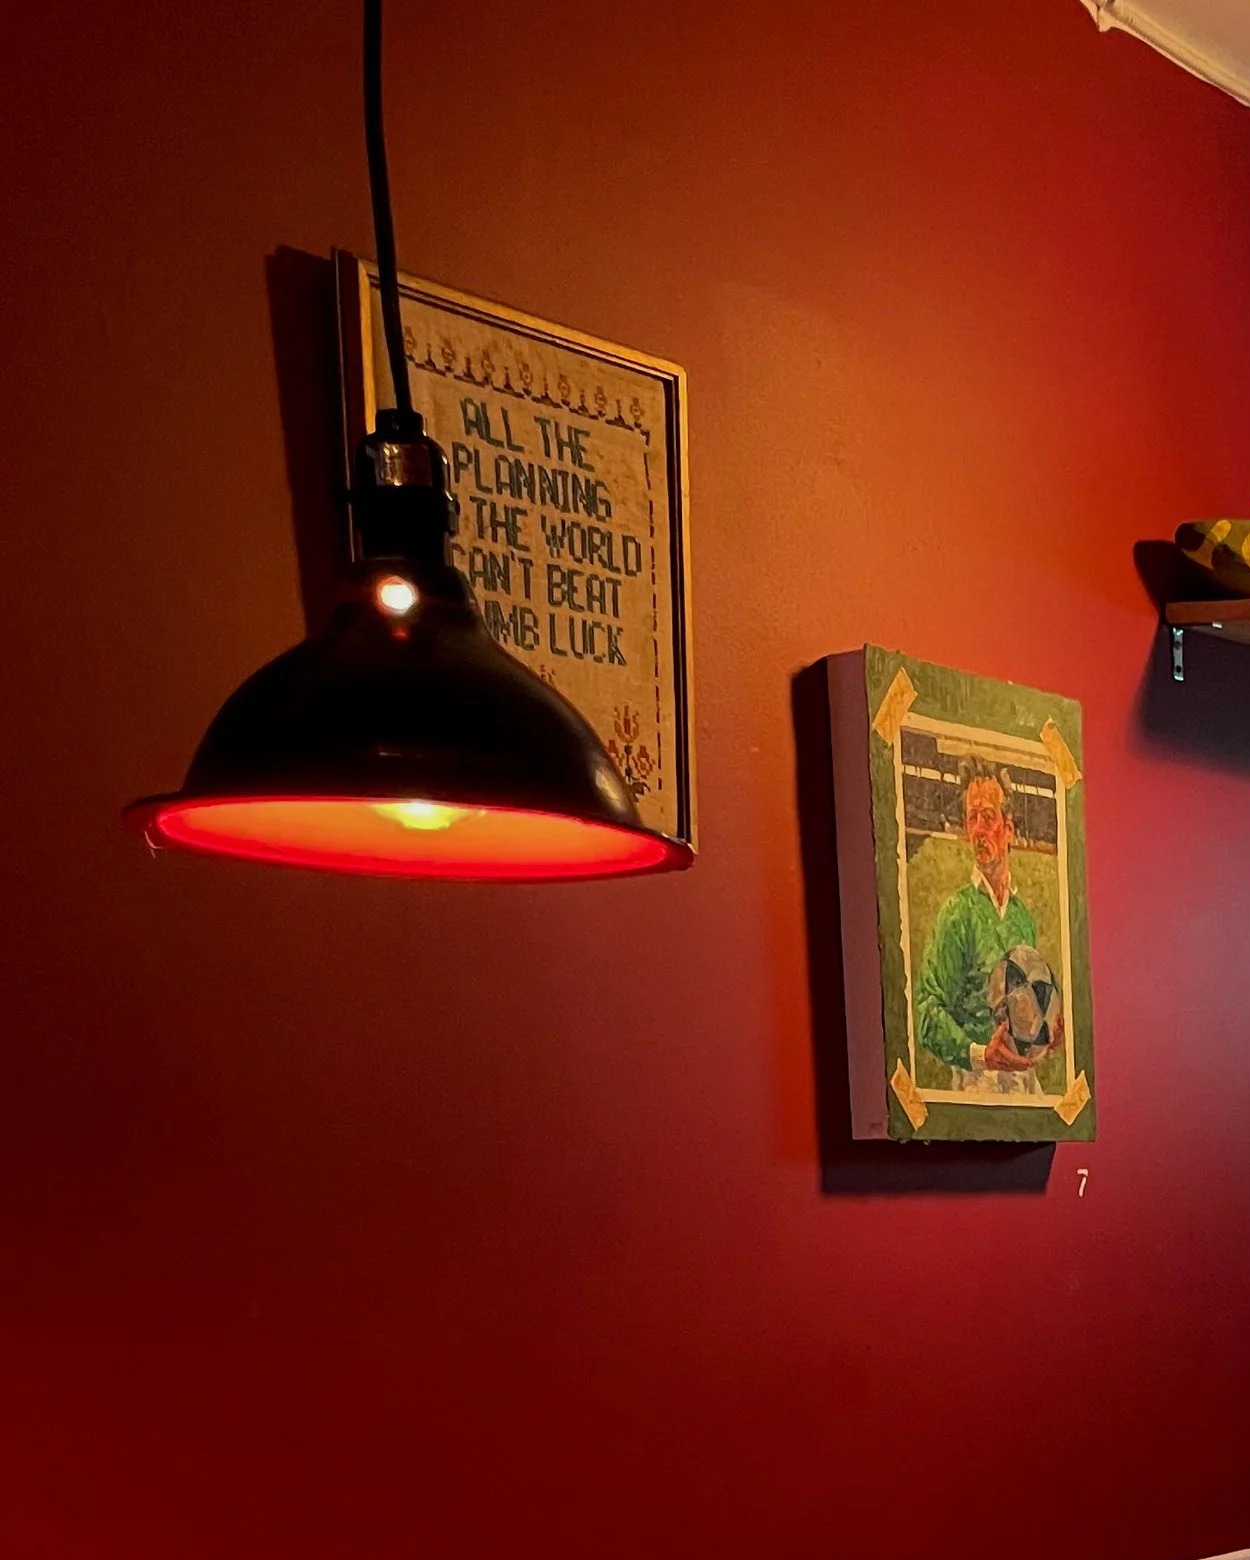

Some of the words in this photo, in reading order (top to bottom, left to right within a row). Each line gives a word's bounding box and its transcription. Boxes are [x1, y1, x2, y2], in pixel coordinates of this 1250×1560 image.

[460, 398, 525, 452] ALL
[534, 416, 594, 472] THE
[451, 441, 612, 519] PLANNING
[469, 496, 531, 552] THE
[541, 516, 643, 578] WORLD
[547, 565, 623, 619] BEAT
[549, 617, 628, 667] LUCK
